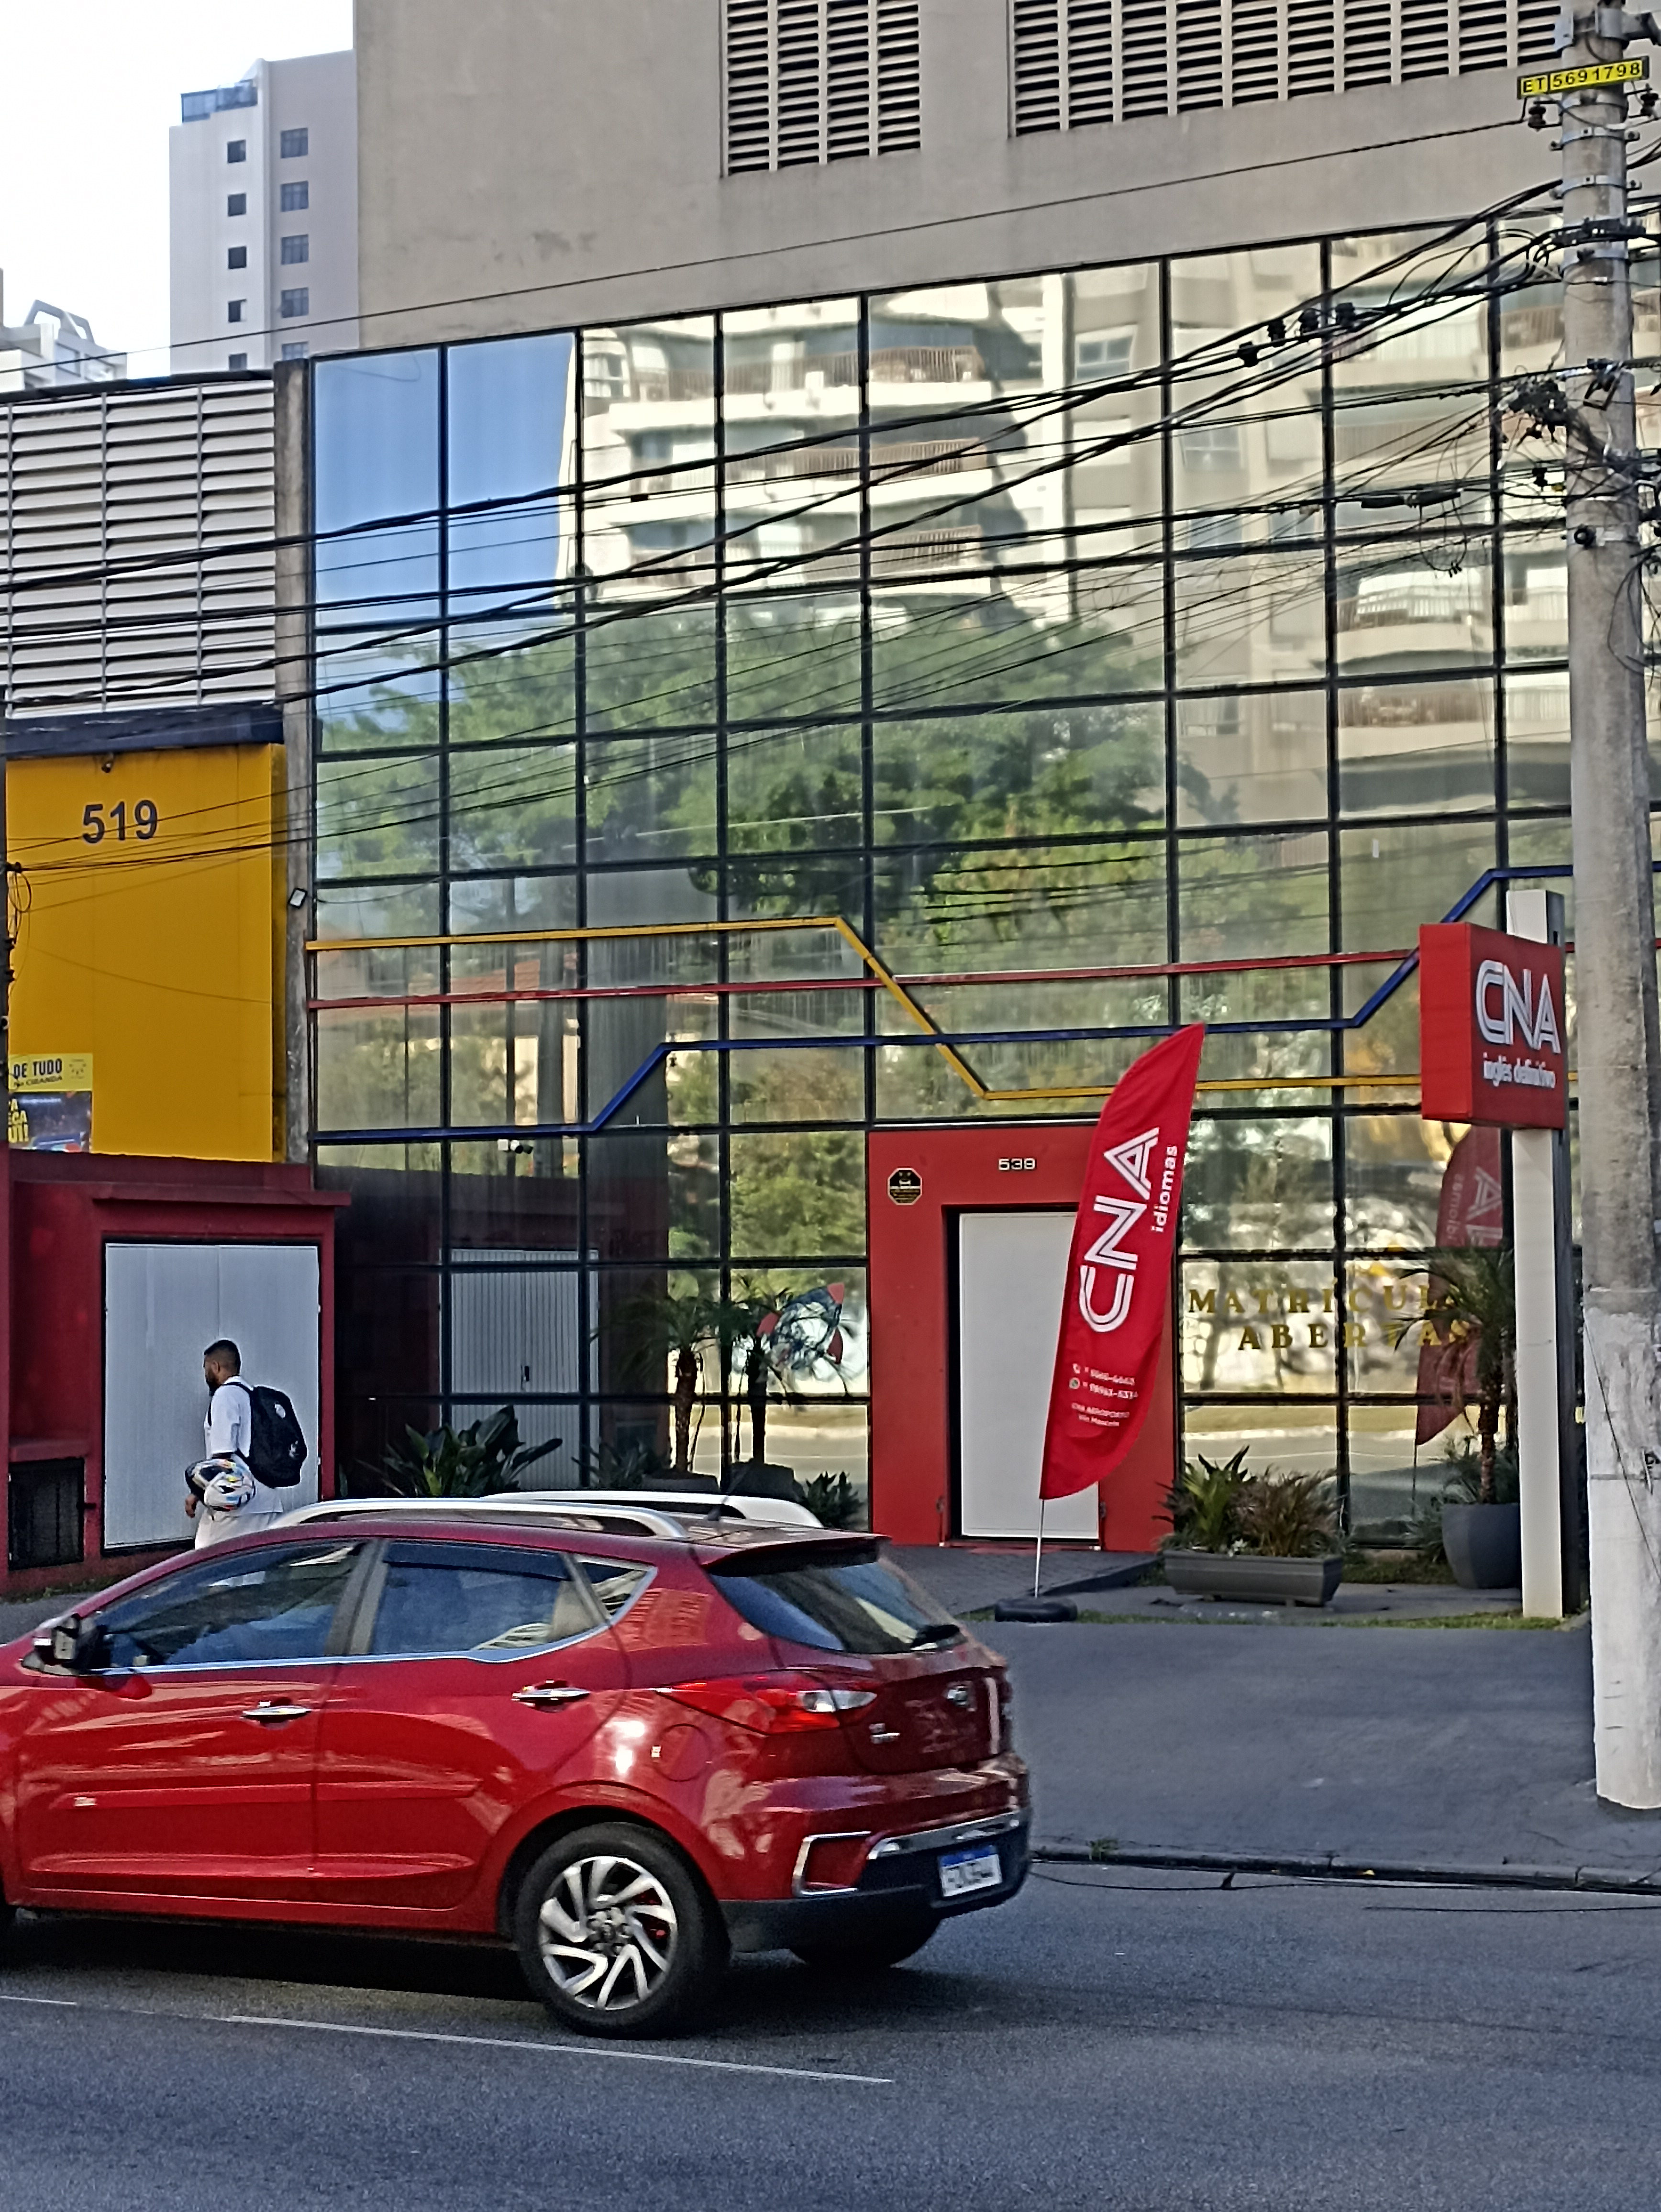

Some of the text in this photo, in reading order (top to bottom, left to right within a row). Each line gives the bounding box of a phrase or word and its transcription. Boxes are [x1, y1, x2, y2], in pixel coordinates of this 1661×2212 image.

[1523, 62, 1640, 93] ET 5691798
[82, 799, 157, 843] 519
[1476, 960, 1561, 1054] CNA
[33, 1058, 62, 1076] TUDO
[1151, 1145, 1178, 1233] idiomas
[1079, 1127, 1160, 1332] CNA
